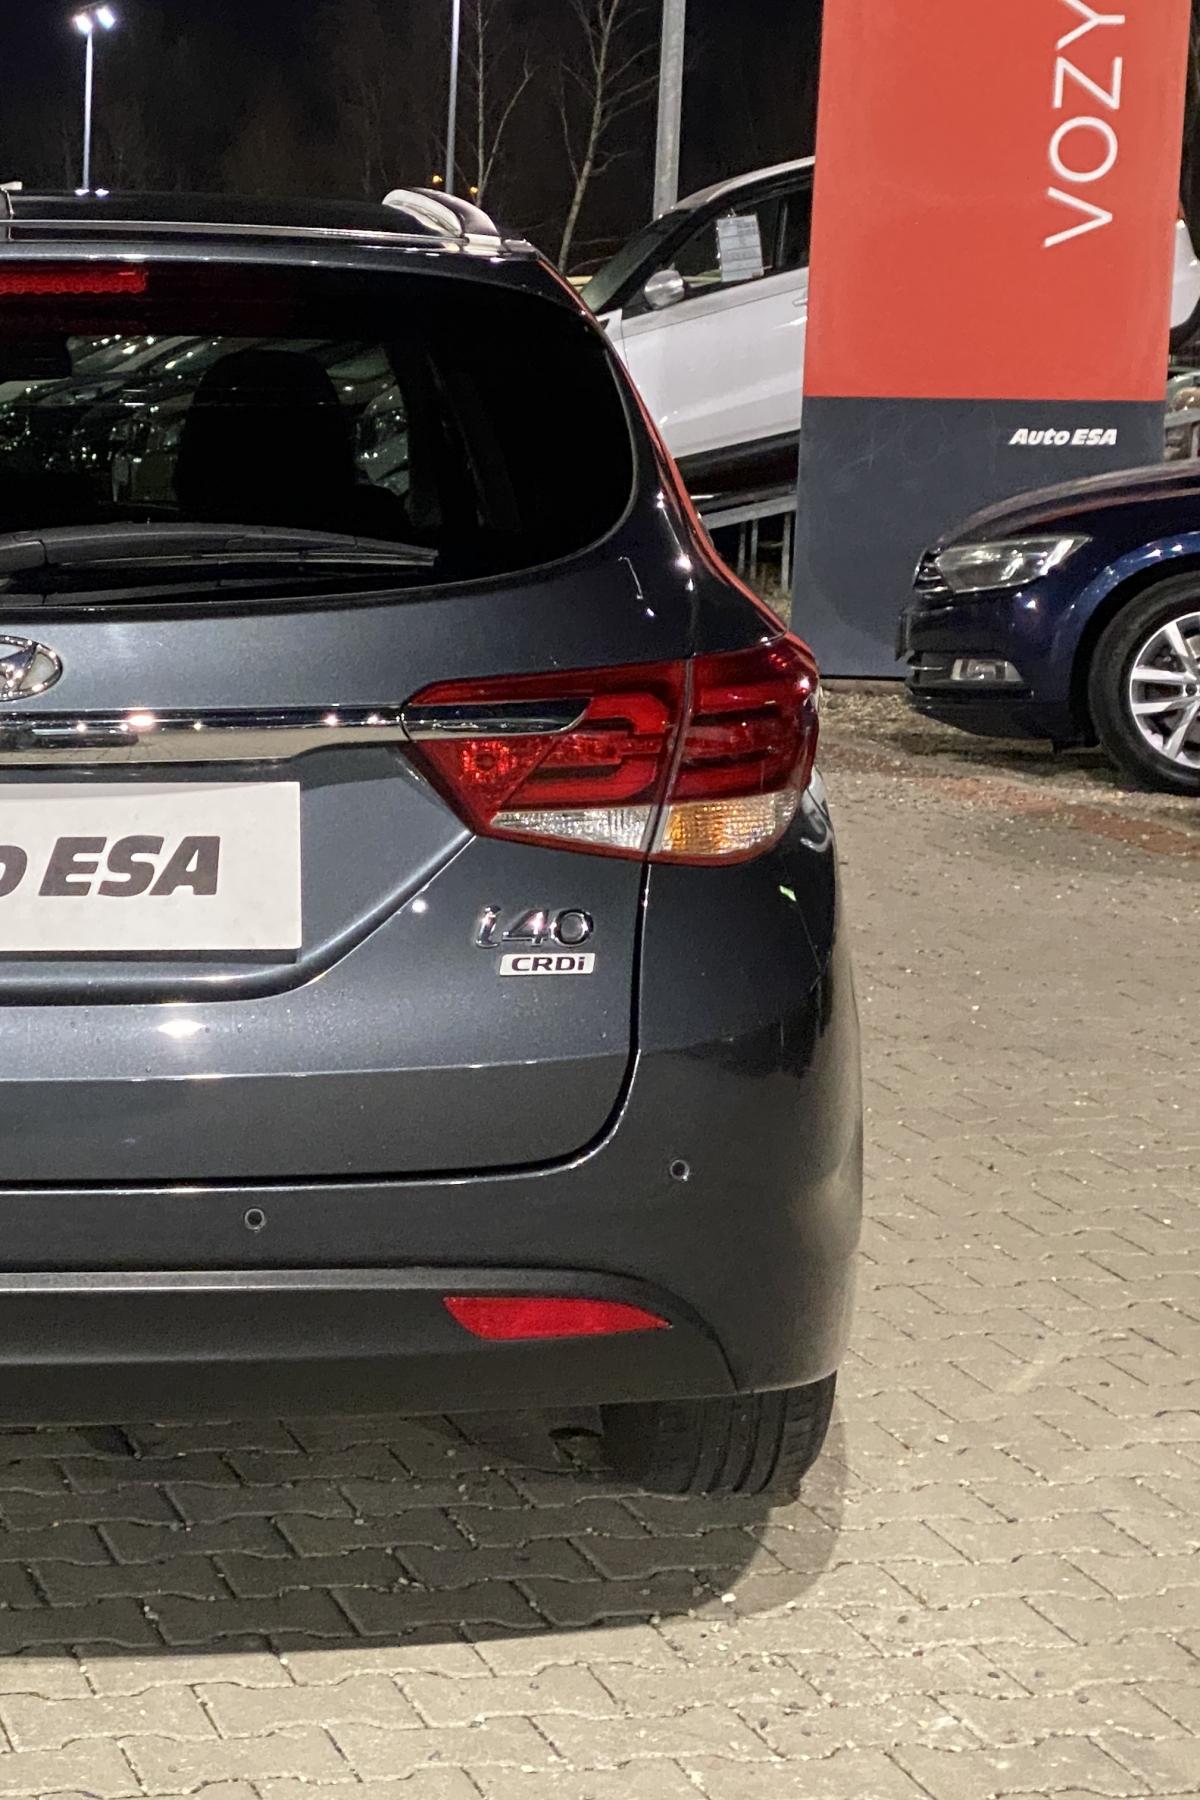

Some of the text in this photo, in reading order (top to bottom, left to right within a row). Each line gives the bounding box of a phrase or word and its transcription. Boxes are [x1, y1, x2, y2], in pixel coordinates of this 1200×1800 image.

[1044, 0, 1125, 248] VOZY
[1008, 428, 1118, 446] Auto ESA
[38, 835, 221, 897] ESA
[475, 905, 595, 949] i40
[511, 956, 586, 972] CRDi
